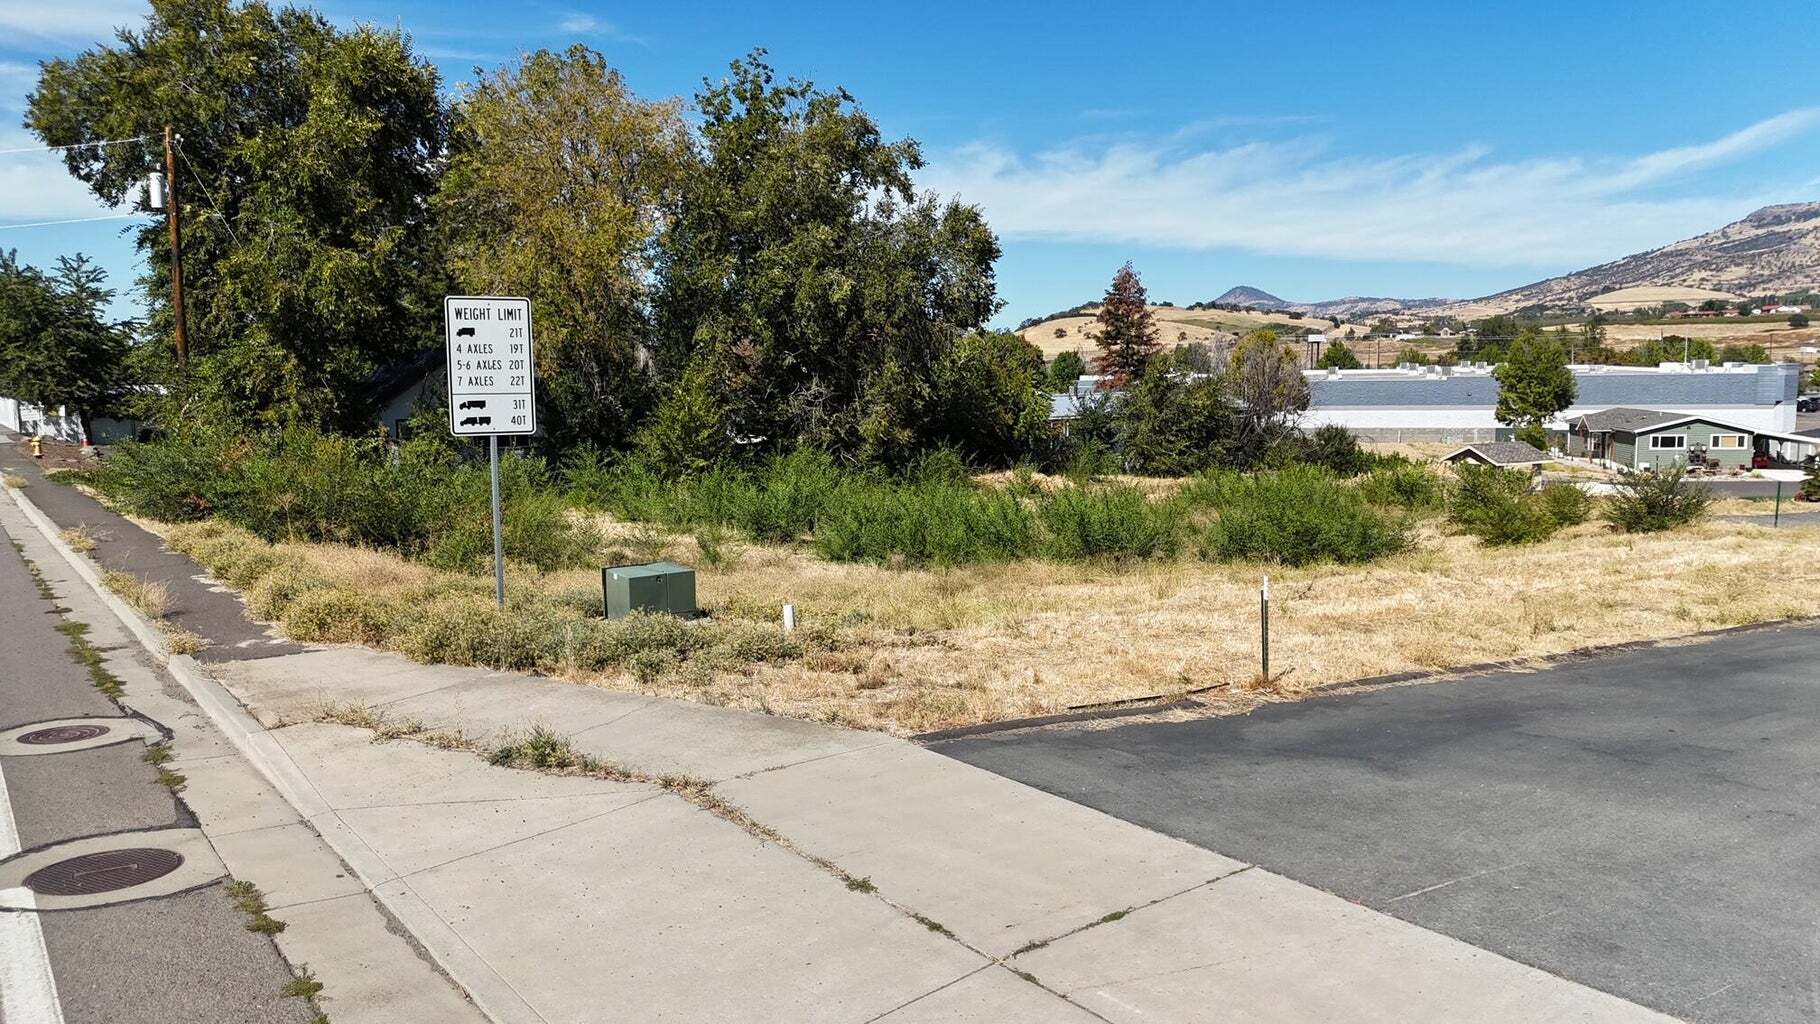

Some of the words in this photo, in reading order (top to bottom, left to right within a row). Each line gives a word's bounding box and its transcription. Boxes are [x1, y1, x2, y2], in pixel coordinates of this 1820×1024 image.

[454, 307, 491, 320] WEIGHT
[497, 308, 522, 320] LIMIT
[509, 327, 523, 338] 21T
[456, 343, 462, 354] 4
[467, 343, 494, 354] AXLES
[510, 343, 524, 354] 19T
[457, 360, 471, 370] 5-6
[476, 360, 502, 370] AXLES
[509, 359, 524, 370] 20T
[457, 376, 463, 386] 7
[468, 376, 494, 386] AXLES
[510, 375, 525, 386] 22T
[513, 399, 526, 410] 31T
[510, 415, 526, 426] 40T
